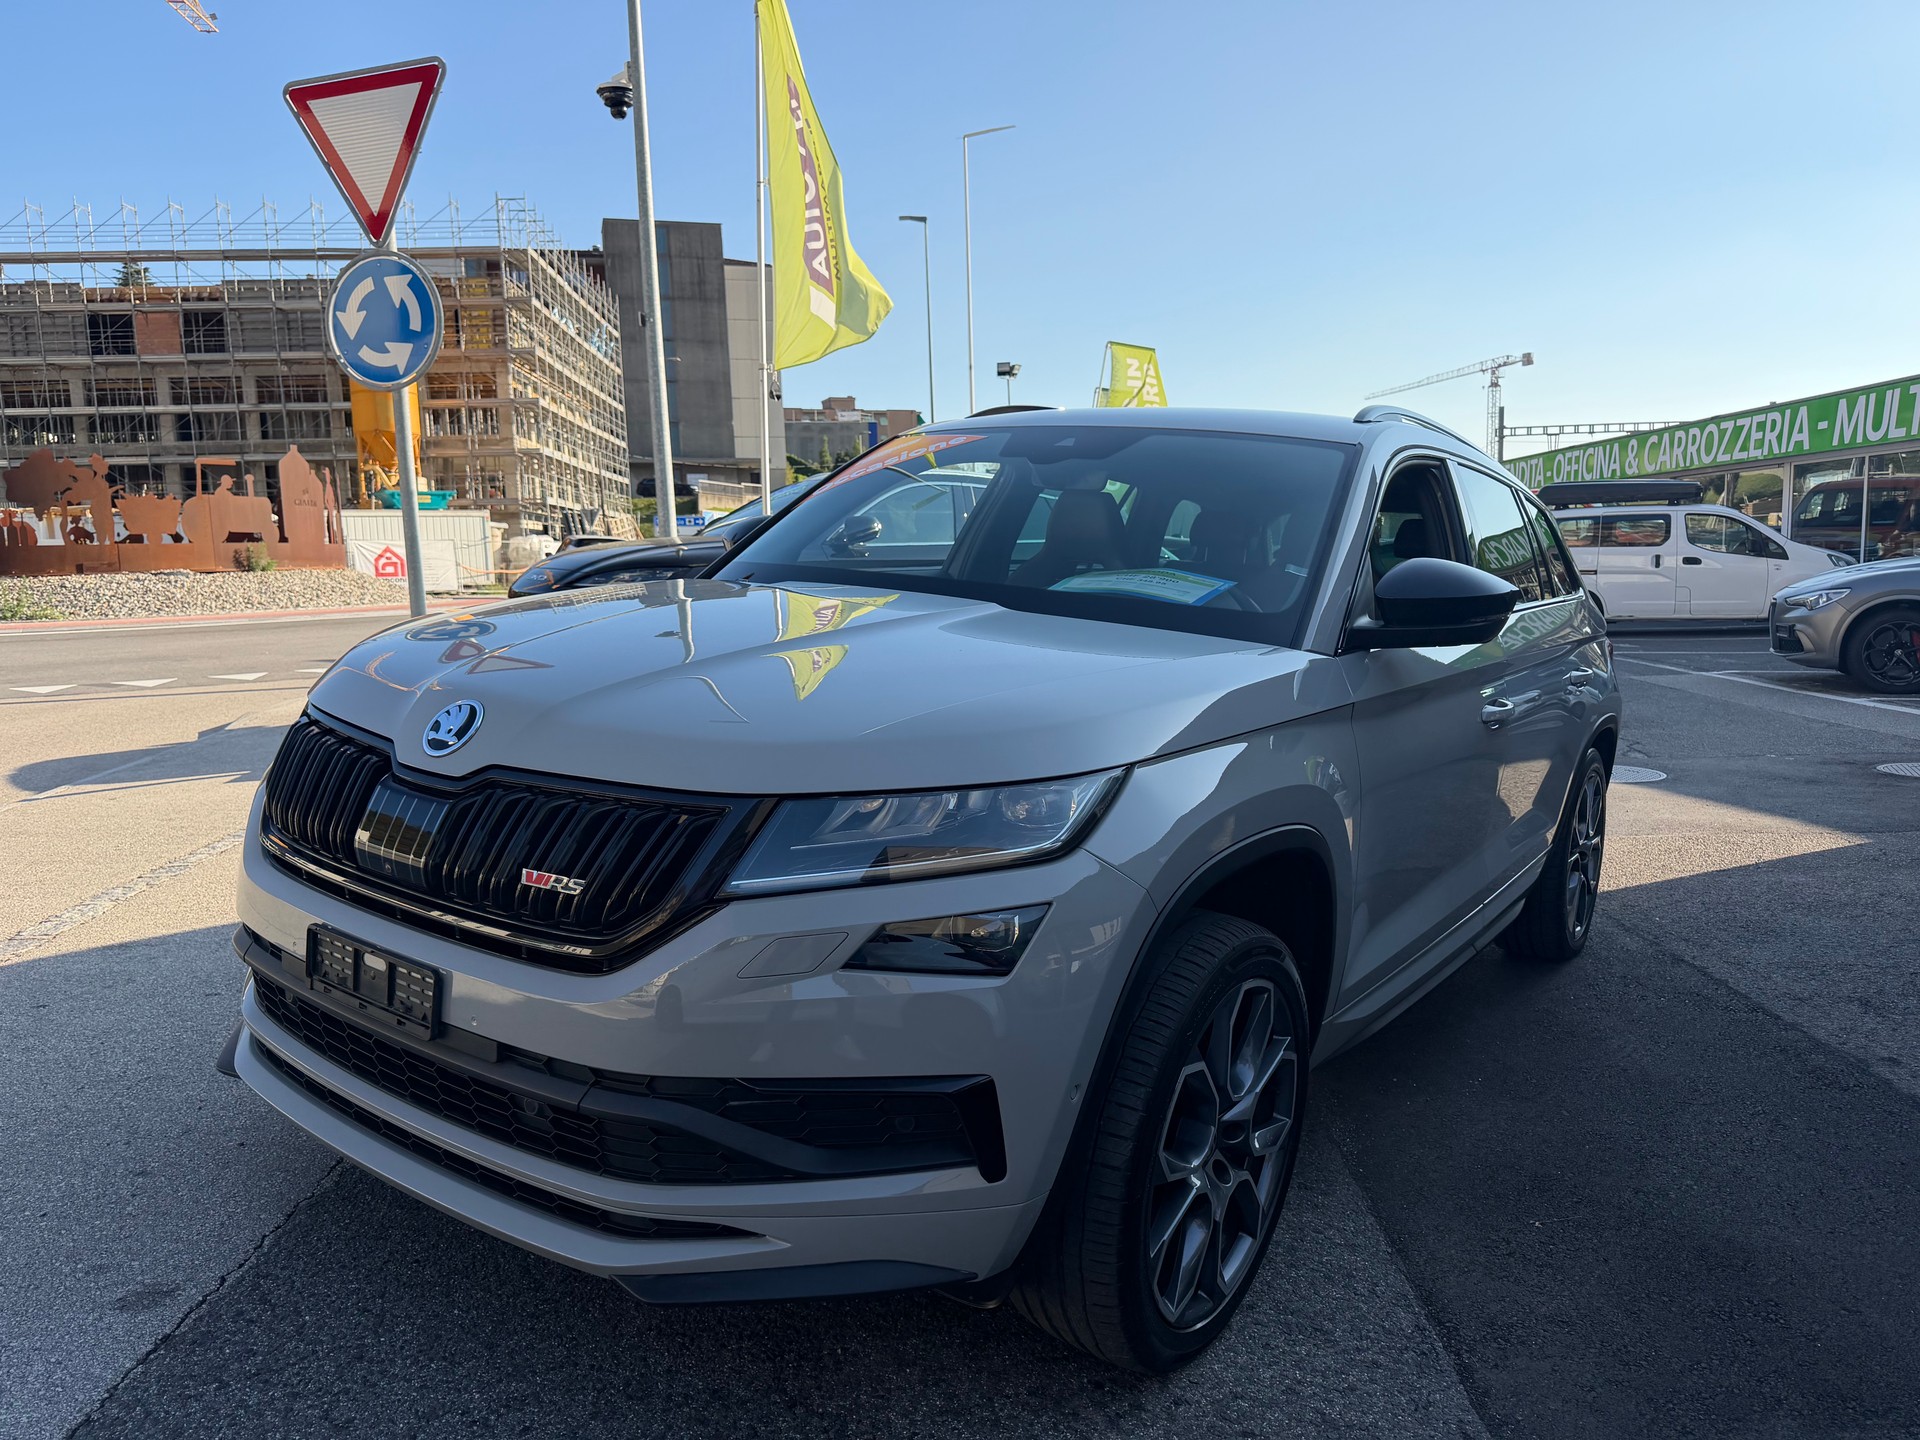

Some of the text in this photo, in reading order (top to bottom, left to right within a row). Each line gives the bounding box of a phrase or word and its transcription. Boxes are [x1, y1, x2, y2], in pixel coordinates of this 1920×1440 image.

[1553, 442, 1620, 482] OFFICINA
[1624, 438, 1639, 475] &
[1643, 405, 1810, 472] CARROZZERIA
